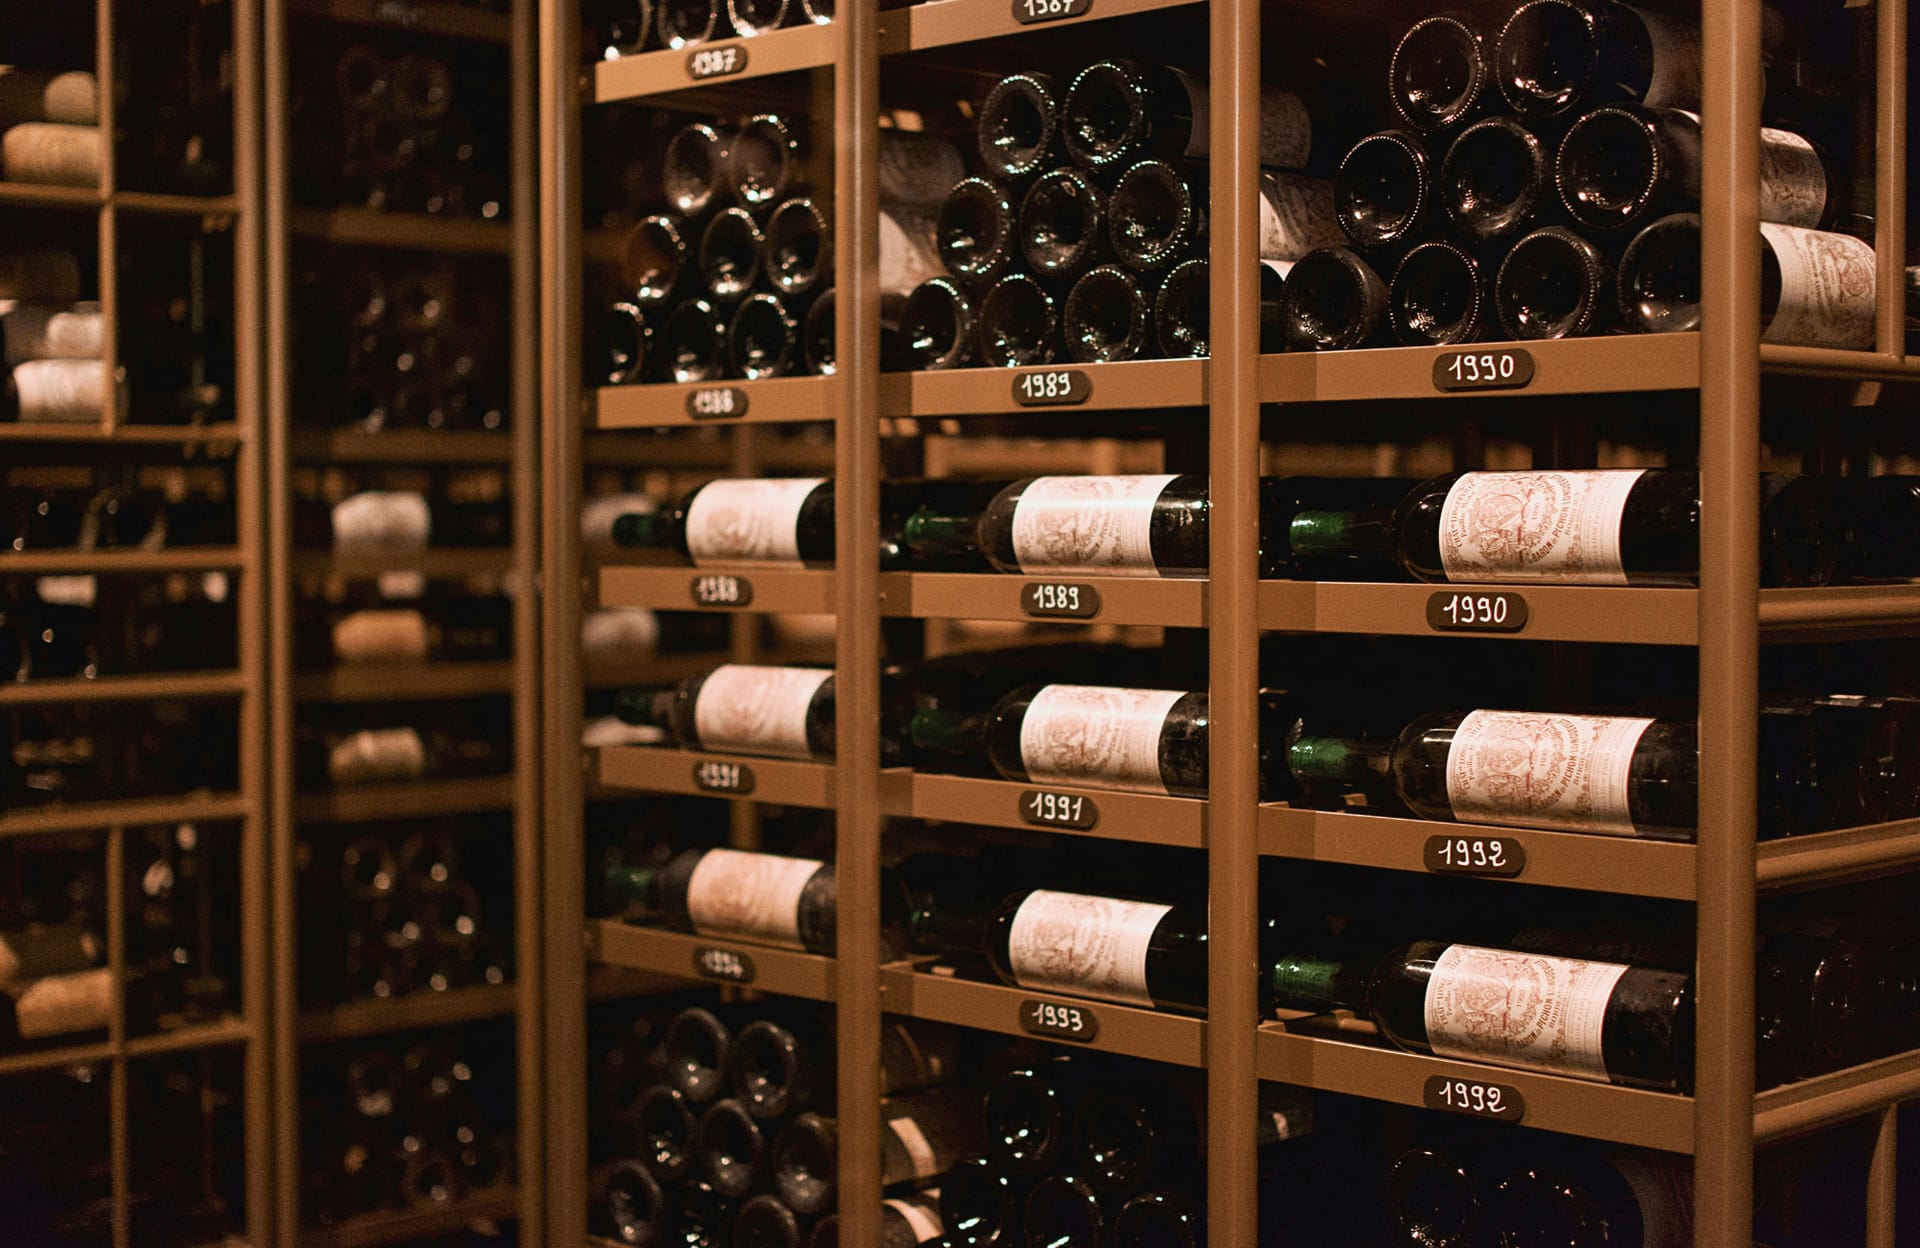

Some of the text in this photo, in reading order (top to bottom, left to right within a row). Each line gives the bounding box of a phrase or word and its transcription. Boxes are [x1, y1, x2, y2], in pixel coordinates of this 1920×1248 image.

[692, 47, 736, 75] 1987
[1448, 354, 1514, 381] 1990
[1021, 372, 1071, 401] 1989
[1551, 507, 1569, 539] PICHON
[1033, 585, 1080, 611] 1989
[1442, 594, 1507, 624] 1990
[1561, 756, 1578, 787] PICHON
[1029, 791, 1082, 822] 1991
[1438, 839, 1507, 867] 1992
[1032, 1003, 1083, 1032] 1993
[1536, 998, 1554, 1030] PICHON
[1438, 1081, 1507, 1113] 1992
